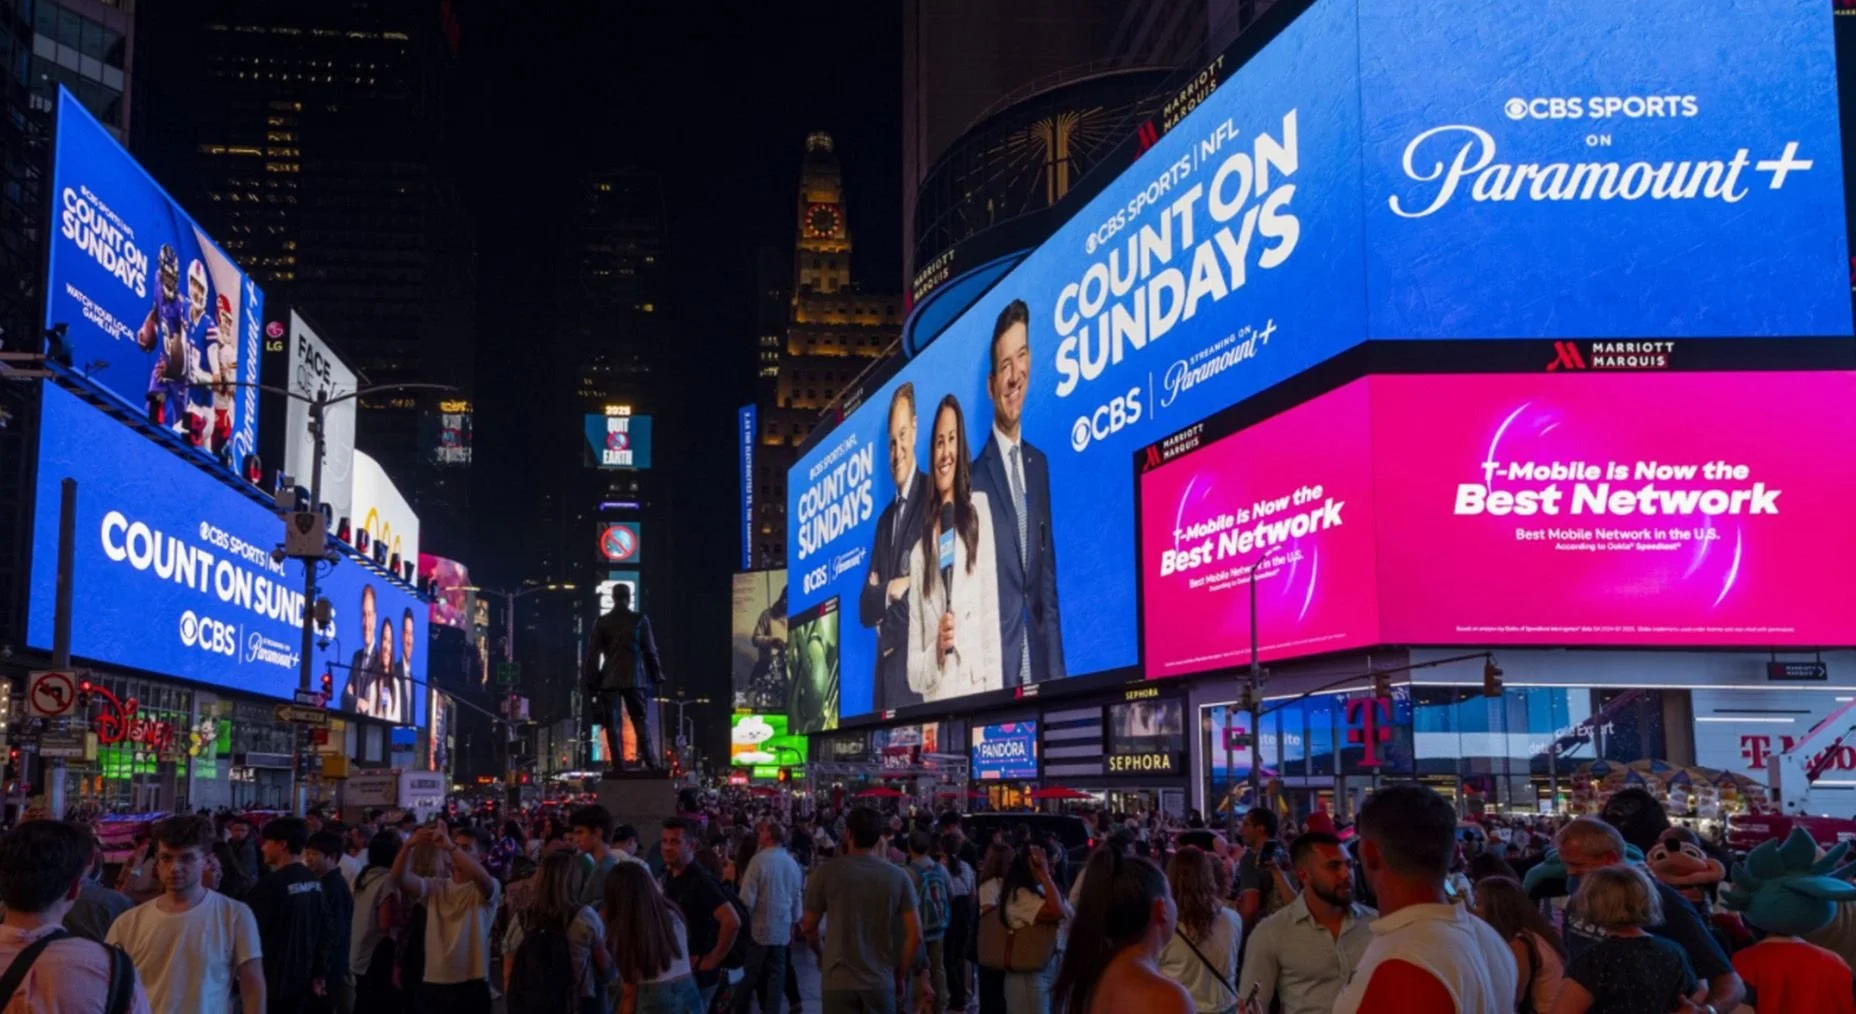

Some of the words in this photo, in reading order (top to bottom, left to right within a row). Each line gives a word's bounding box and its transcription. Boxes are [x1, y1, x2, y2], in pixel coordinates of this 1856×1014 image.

[1163, 54, 1225, 118] MARRIOTT
[1163, 79, 1217, 133] MARQUIS
[1528, 97, 1584, 119] CBS
[1588, 95, 1699, 118] SPORTS
[1586, 134, 1612, 147] ON
[1096, 208, 1126, 246] CBS
[1128, 153, 1191, 222] SPORTS
[1201, 118, 1240, 162] NFL
[1388, 124, 1813, 218] Paramount+
[63, 187, 124, 253] COUNT
[124, 240, 148, 275] ON
[1054, 182, 1203, 337] COUNT
[1208, 108, 1299, 224] ON
[62, 210, 147, 299] SUNDAYS
[913, 249, 955, 290] MARRIOTT
[913, 267, 949, 303] MARQUIS
[1055, 184, 1300, 398] SUNDAYS
[266, 341, 283, 351] LG
[298, 332, 331, 386] FACE
[1160, 319, 1277, 407] Paramount+
[1190, 333, 1236, 366] STREAMING
[1238, 325, 1252, 338] ON
[1592, 341, 1675, 353] MARRIOTT
[1593, 356, 1666, 367] MARQUIS
[1090, 386, 1142, 441] CBS
[1163, 423, 1204, 449] MARRIOTT
[1163, 437, 1200, 460] MARQUIS
[798, 462, 847, 524] COUNT
[847, 442, 873, 489] ON
[1481, 461, 1602, 481] T-Mobile
[1605, 461, 1630, 481] is
[1634, 463, 1698, 481] Now
[1701, 461, 1750, 481] the
[1173, 514, 1234, 543] T-Mobile
[1236, 508, 1250, 525] is
[1252, 495, 1290, 520] Now
[1292, 484, 1323, 506] the
[1453, 483, 1562, 516] Best
[1570, 482, 1783, 516] Network
[798, 479, 873, 561] SUNDAYS
[1160, 538, 1215, 577] Best
[1217, 497, 1345, 560] Network
[1515, 528, 1545, 541] Best
[1548, 527, 1593, 541] Mobile
[1595, 528, 1652, 541] Network
[1654, 528, 1666, 541] in
[1668, 528, 1691, 541] the
[1693, 528, 1721, 541] U.S.
[101, 510, 214, 593] COUNT
[215, 559, 253, 610] ON
[209, 526, 229, 550] CBS
[229, 535, 265, 568] SPORTS
[810, 563, 828, 591] CBS
[199, 616, 236, 656] CBS
[1125, 687, 1159, 700] SEPHORA
[981, 741, 1025, 758] PANDORA
[1346, 697, 1392, 767] T
[1109, 753, 1171, 771] SEPHORA
